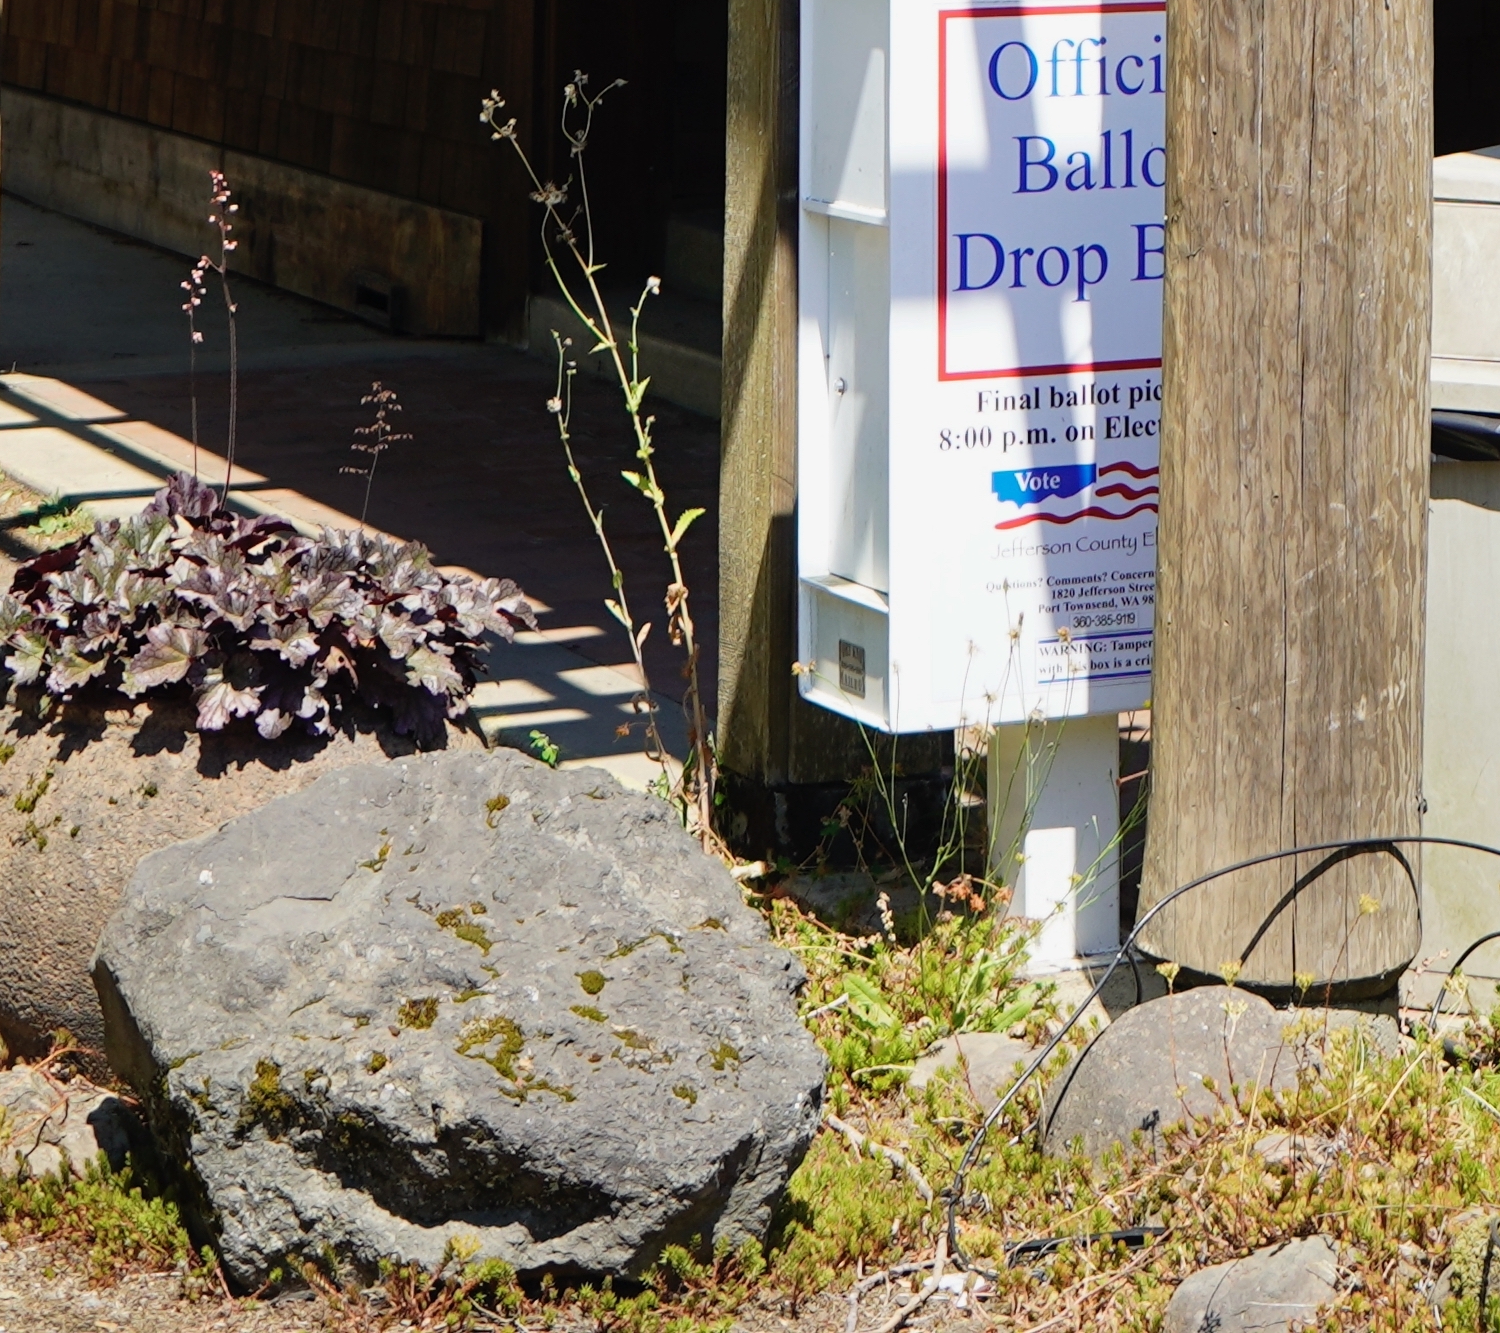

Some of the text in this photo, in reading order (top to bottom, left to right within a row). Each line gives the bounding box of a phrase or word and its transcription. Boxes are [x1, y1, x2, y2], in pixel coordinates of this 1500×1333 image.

[988, 34, 1166, 101] Offici
[1012, 128, 1167, 194] Ballo
[952, 223, 1166, 303] Drop B
[976, 379, 1162, 413] Final ballot pic
[939, 425, 993, 451] 8:00
[1002, 425, 1057, 453] p.m.
[1065, 424, 1095, 442] on
[1014, 472, 1061, 492] Vote
[990, 536, 1071, 559] Jefferson
[1076, 534, 1138, 557] County
[986, 570, 1155, 591] Qustions? Comments? Concern
[1052, 583, 1155, 600] 1820 Jefferson Stree
[1038, 595, 1155, 614] Port Townsend, WA 98
[1073, 612, 1136, 628] 360-385-9119
[1038, 641, 1108, 657] WARNING:
[1038, 663, 1063, 675] with
[1090, 657, 1110, 670] box
[1113, 656, 1123, 668] is
[1125, 658, 1132, 667] a
